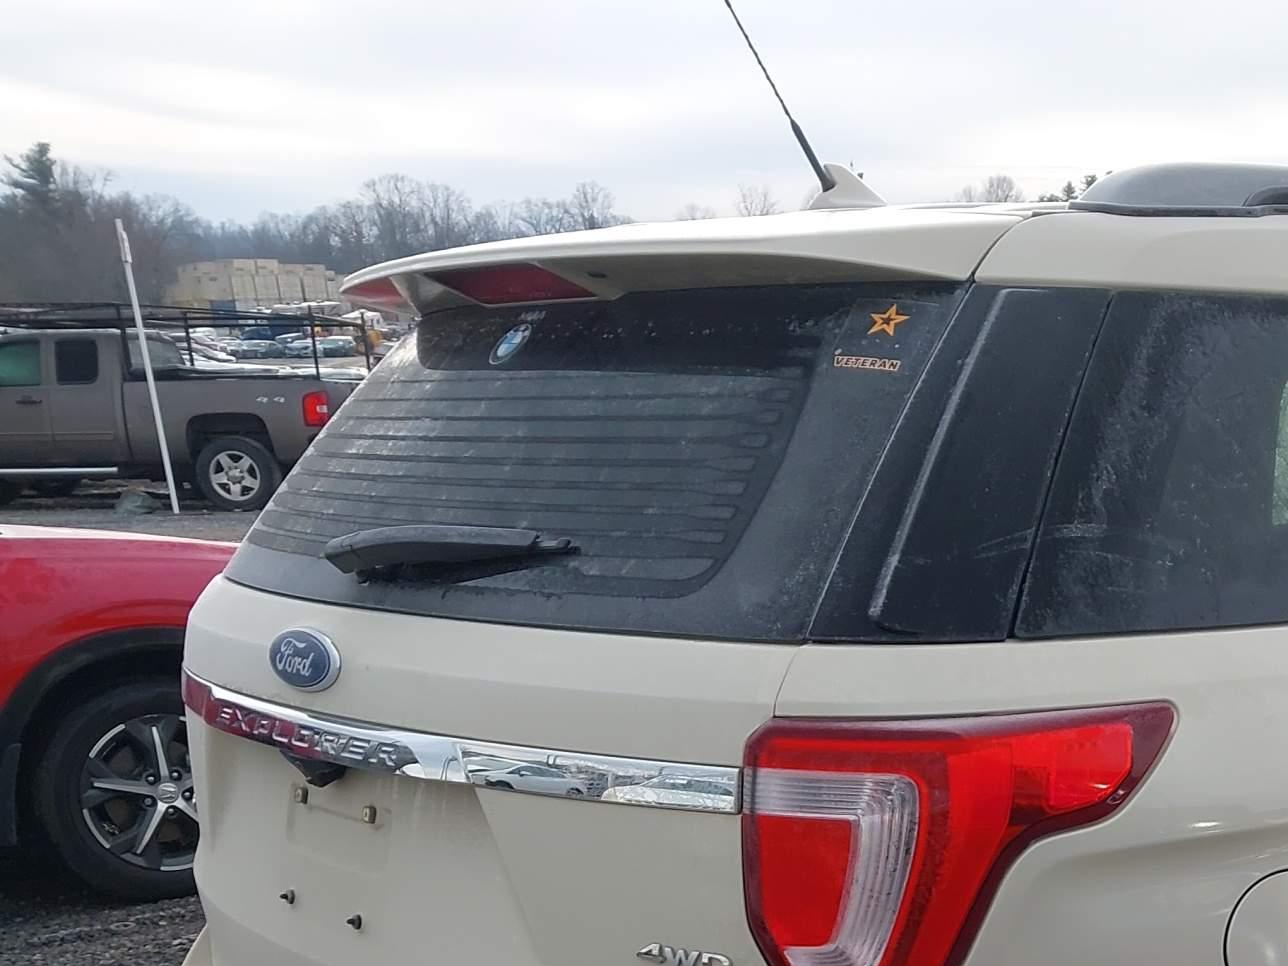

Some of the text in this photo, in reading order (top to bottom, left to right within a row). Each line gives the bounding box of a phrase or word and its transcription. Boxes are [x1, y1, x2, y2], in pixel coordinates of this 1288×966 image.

[834, 356, 900, 371] VETERAN
[275, 637, 316, 677] Ford
[216, 704, 399, 767] EXPLORER
